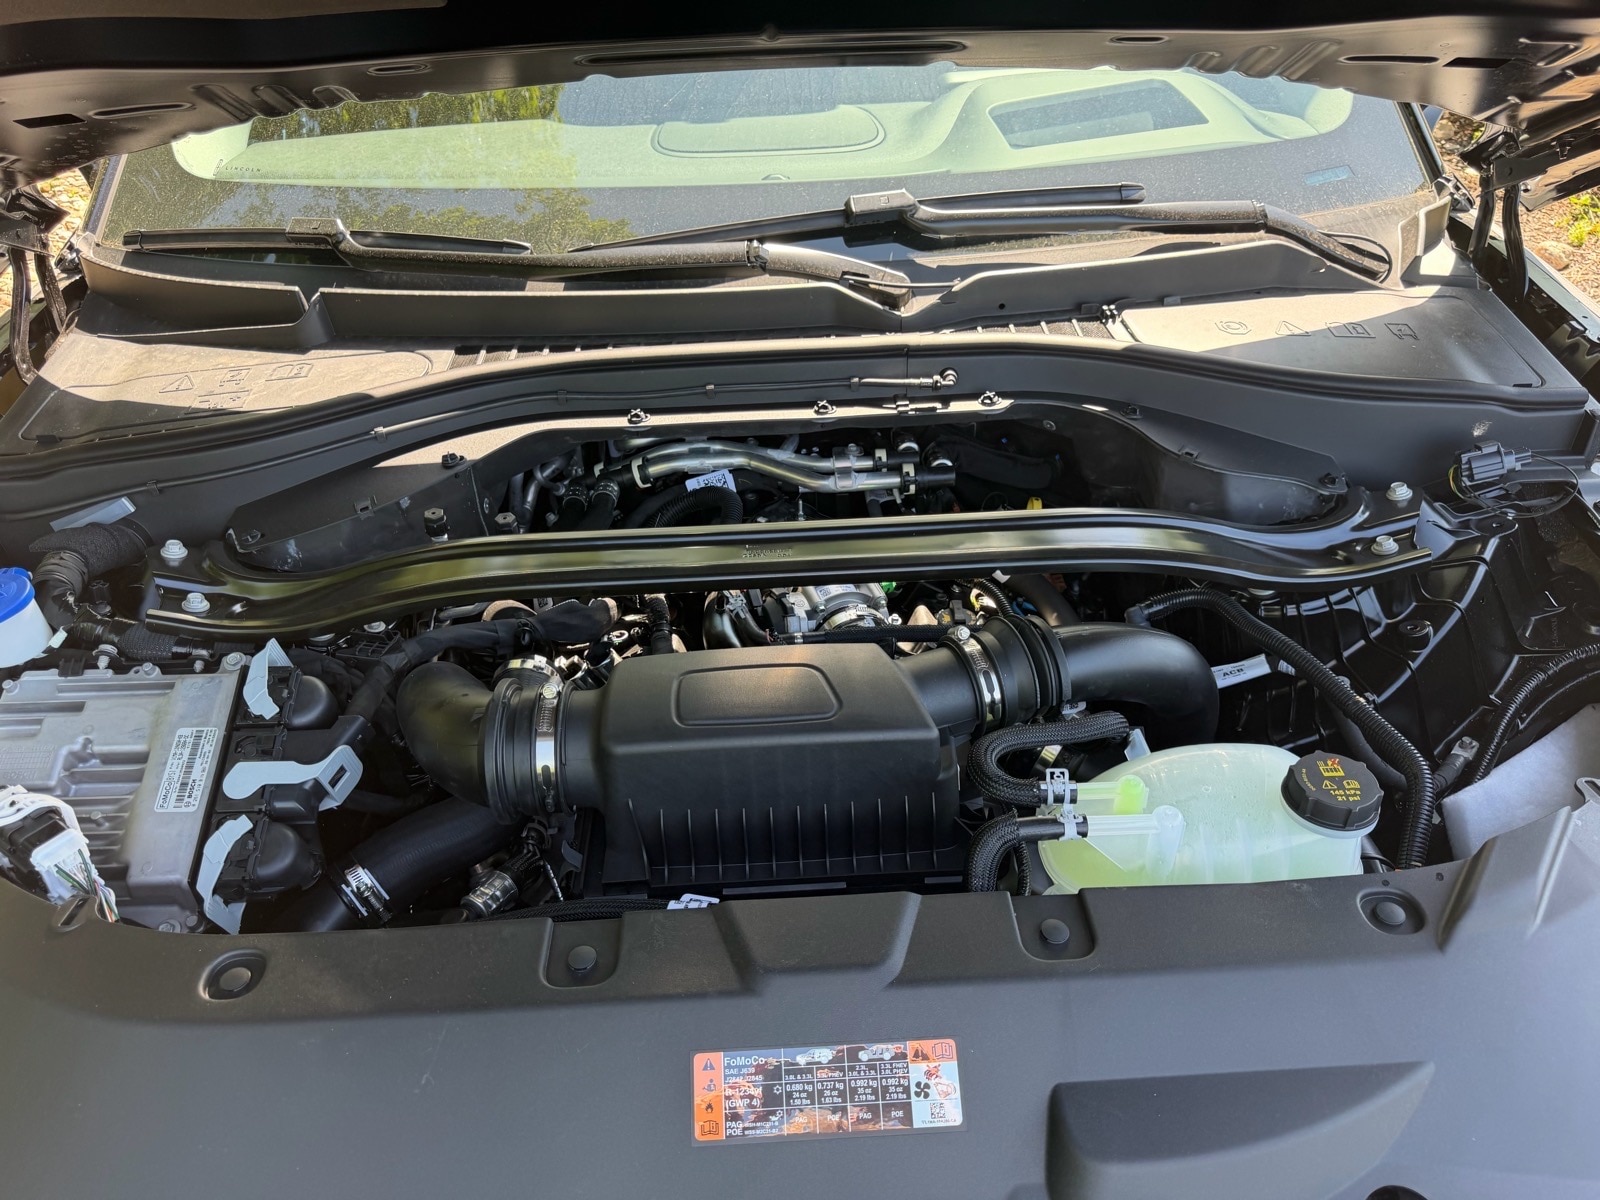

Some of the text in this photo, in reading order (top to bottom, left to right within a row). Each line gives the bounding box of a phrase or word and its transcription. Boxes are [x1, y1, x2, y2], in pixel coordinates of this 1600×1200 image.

[187, 779, 197, 799] BOSCH
[160, 781, 173, 808] FoMoCo
[724, 1056, 765, 1066] FoMoCo
[836, 1081, 844, 1089] kg
[869, 1079, 877, 1087] kg
[900, 1078, 908, 1086] kg
[804, 1083, 812, 1091] kg
[726, 1098, 760, 1108] (GWP 4)
